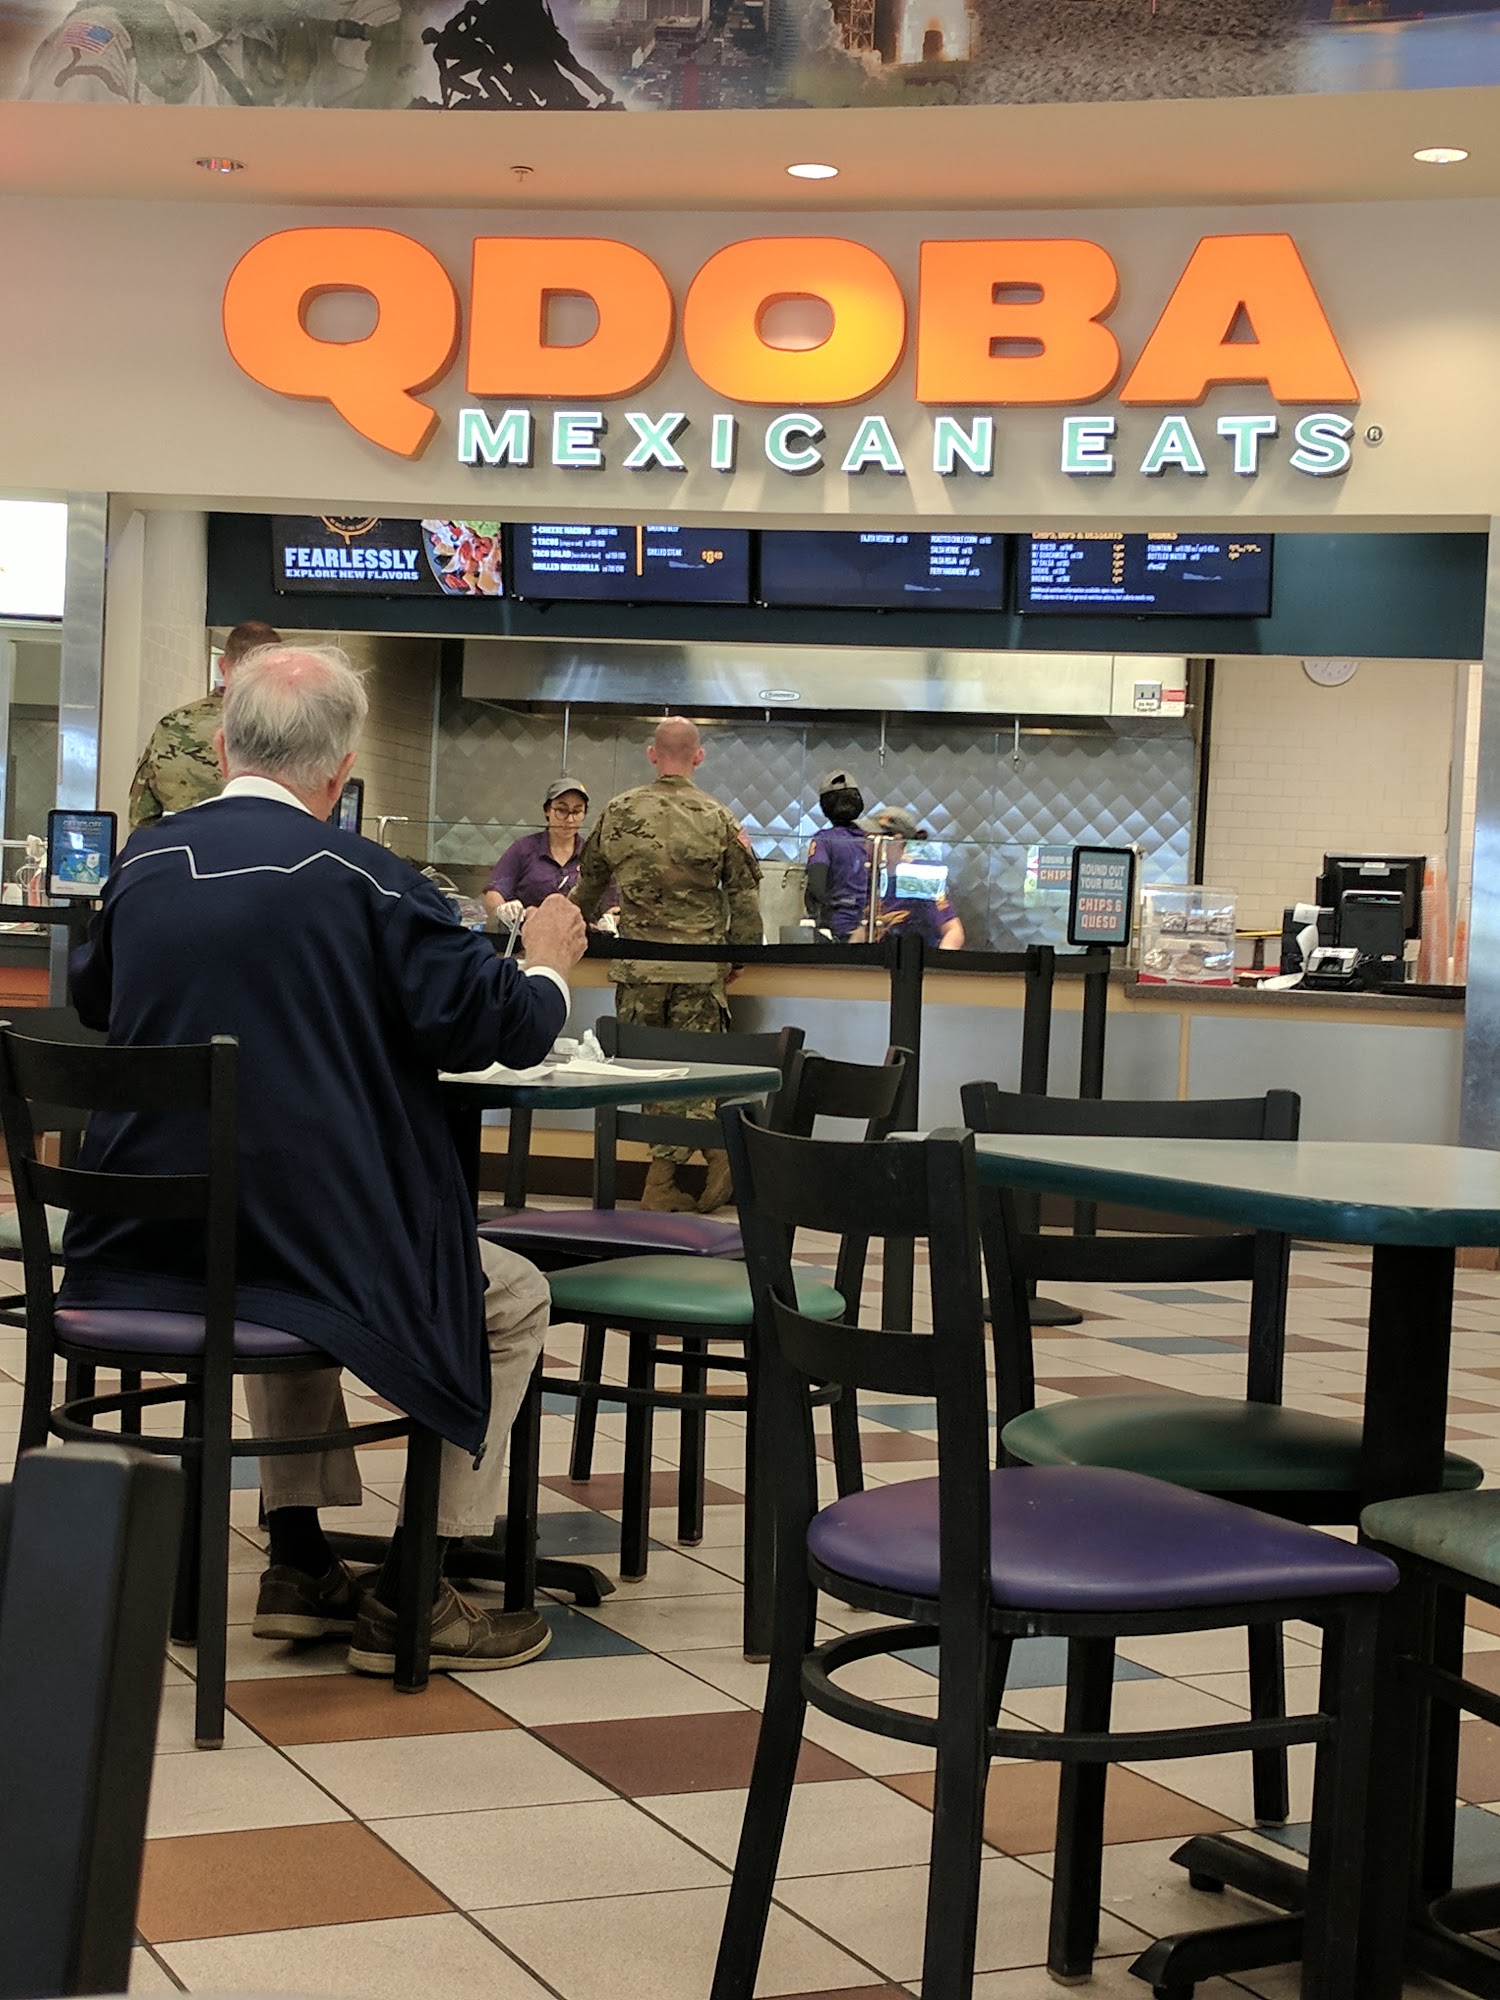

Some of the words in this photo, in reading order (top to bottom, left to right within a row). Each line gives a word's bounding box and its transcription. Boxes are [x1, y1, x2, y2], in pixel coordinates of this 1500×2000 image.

[223, 227, 1360, 460] QDOBA
[459, 407, 995, 476] MEXICAN
[1060, 412, 1357, 477] EATS
[284, 547, 419, 569] FEARLESSLY
[285, 569, 338, 578] EXPLORE
[339, 569, 366, 580] NEW
[367, 570, 419, 580] FLAVORS
[1040, 869, 1072, 880] CHIPS
[1081, 864, 1107, 876] ROUND
[1108, 865, 1125, 877] OUT
[1081, 878, 1102, 889] YOUR
[1103, 878, 1124, 891] MEAL
[1078, 897, 1114, 912] CHIPS
[1080, 914, 1118, 929] QUESO
